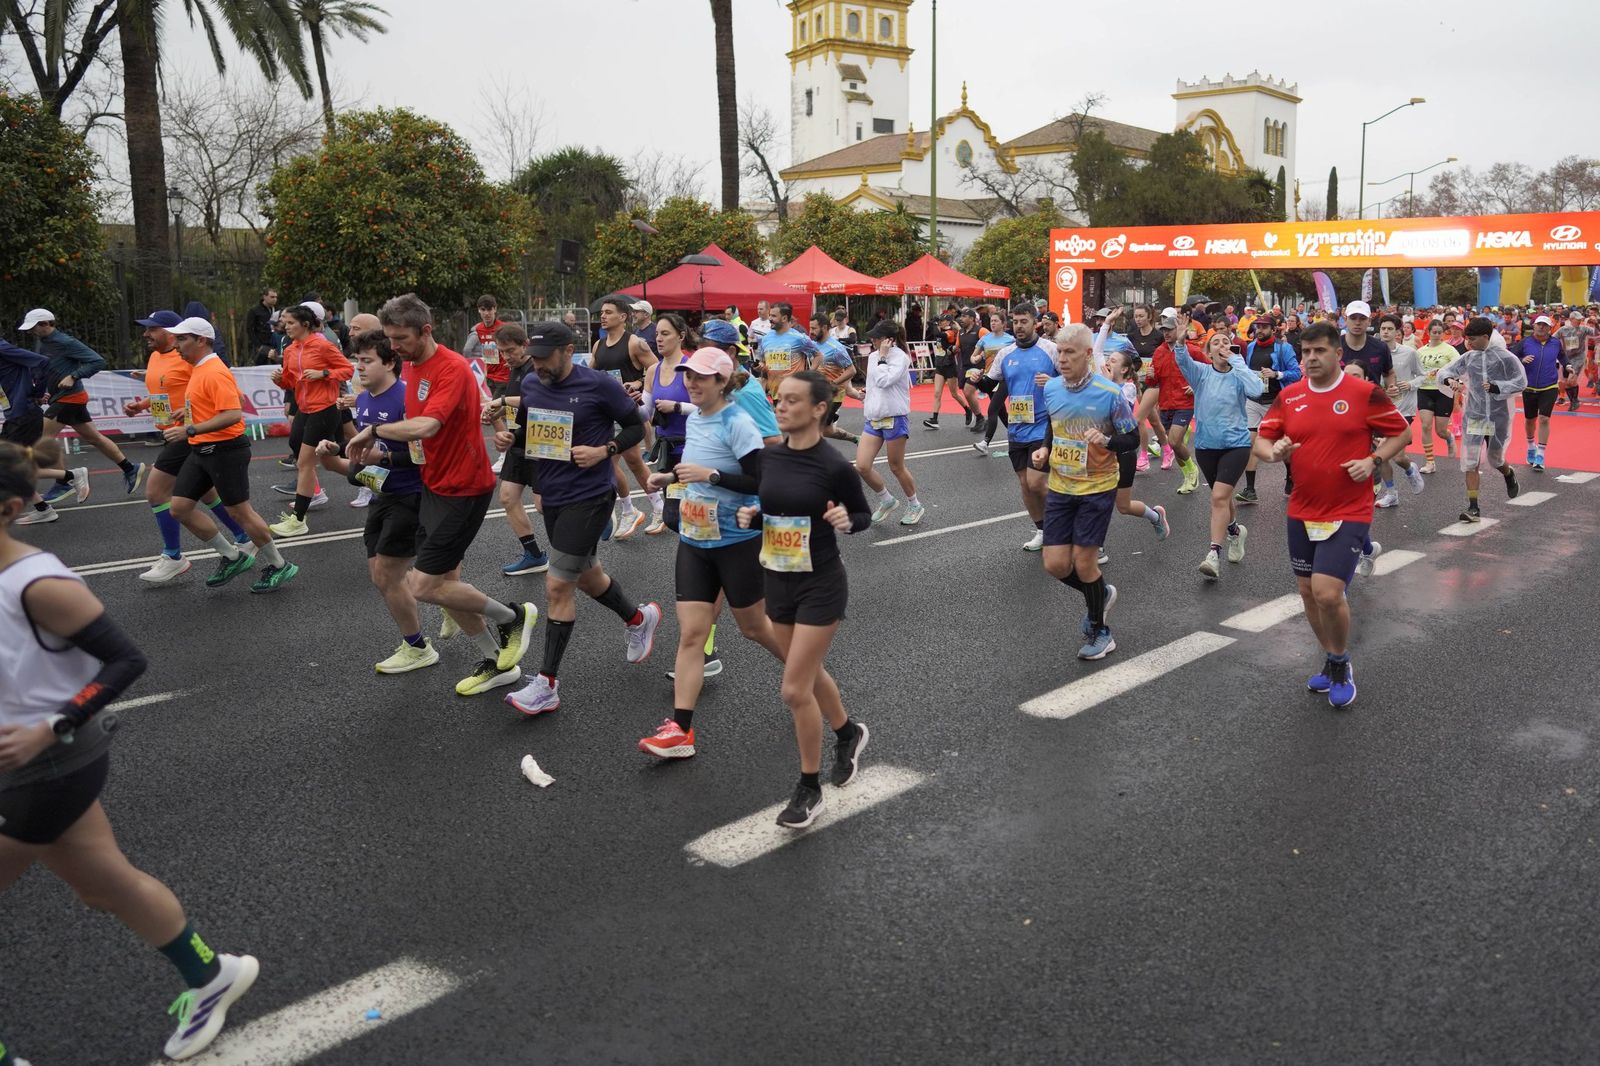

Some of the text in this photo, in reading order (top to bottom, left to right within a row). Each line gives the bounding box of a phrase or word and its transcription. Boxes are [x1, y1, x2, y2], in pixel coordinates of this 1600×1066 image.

[1313, 228, 1386, 244] maratón
[1476, 231, 1533, 248] HOKA
[1331, 241, 1387, 257] sevilla
[1543, 242, 1588, 251] HYUNDAI
[531, 423, 565, 440] 17583
[1055, 446, 1081, 461] 14612
[766, 529, 802, 547] 13492
